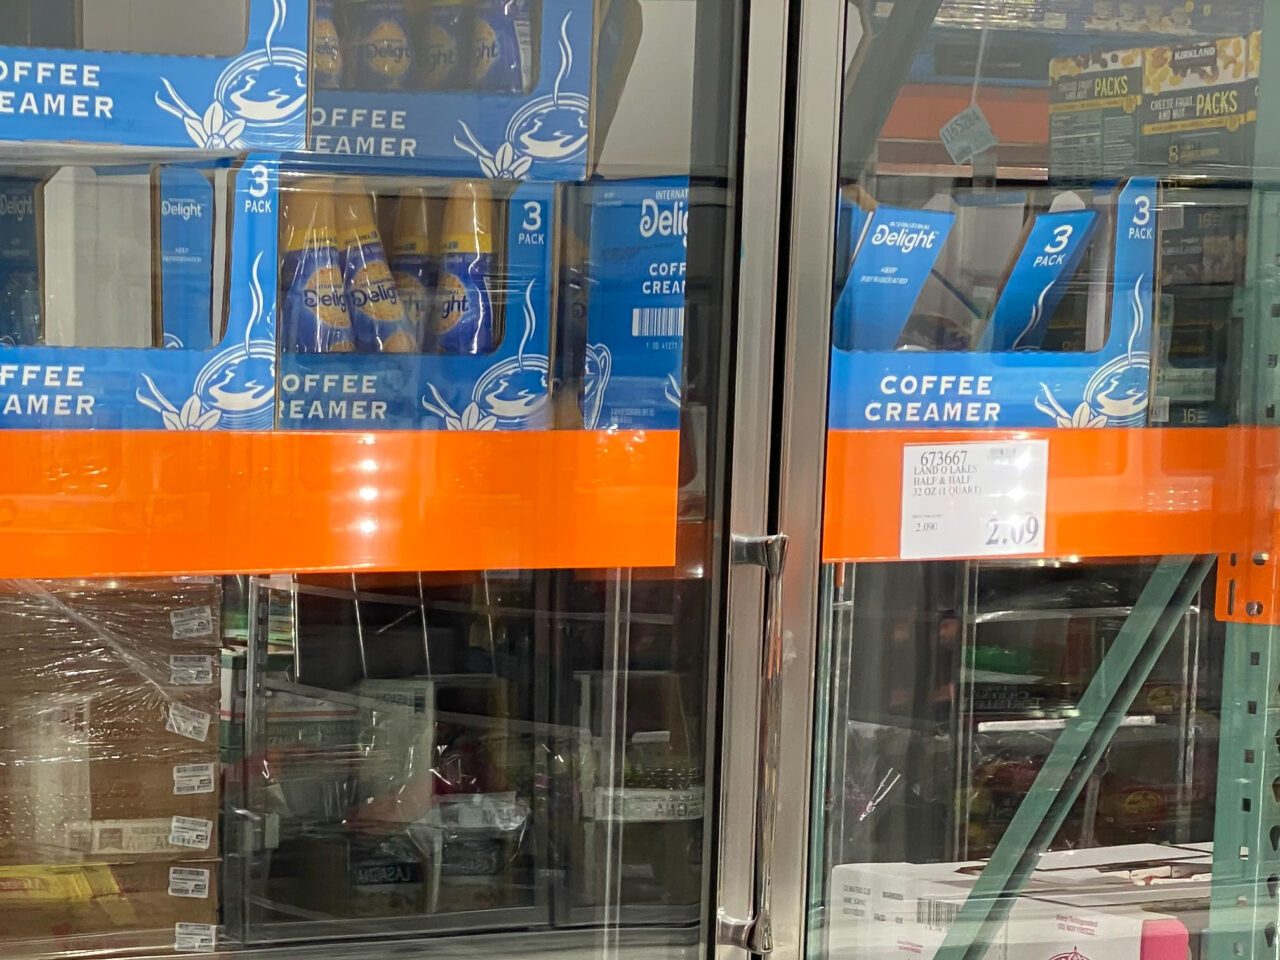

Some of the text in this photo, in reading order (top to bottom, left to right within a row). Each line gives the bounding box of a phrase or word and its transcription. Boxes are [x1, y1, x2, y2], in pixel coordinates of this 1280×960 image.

[1174, 46, 1216, 61] KIRKLAND
[1094, 76, 1128, 97] PACKS
[1196, 90, 1238, 116] PACKS
[310, 136, 417, 158] EAMER
[249, 165, 268, 197] 3
[162, 201, 202, 220] Delight
[245, 200, 271, 213] PACK
[522, 201, 542, 230] 3
[1133, 196, 1150, 225] 3
[518, 232, 544, 245] PACK
[872, 223, 936, 254] Delight
[1045, 224, 1073, 253] 3
[1129, 226, 1152, 240] PACK
[1034, 253, 1064, 268] PACK
[282, 374, 378, 393] OFFEE
[880, 376, 993, 396] COFFEE
[865, 402, 1000, 422] CREAMER
[920, 451, 967, 467] 673667
[914, 465, 977, 475] LAND O LAKES
[914, 475, 971, 486] HALF & HALF
[924, 487, 937, 496] OZ
[986, 516, 1039, 546] 2.09
